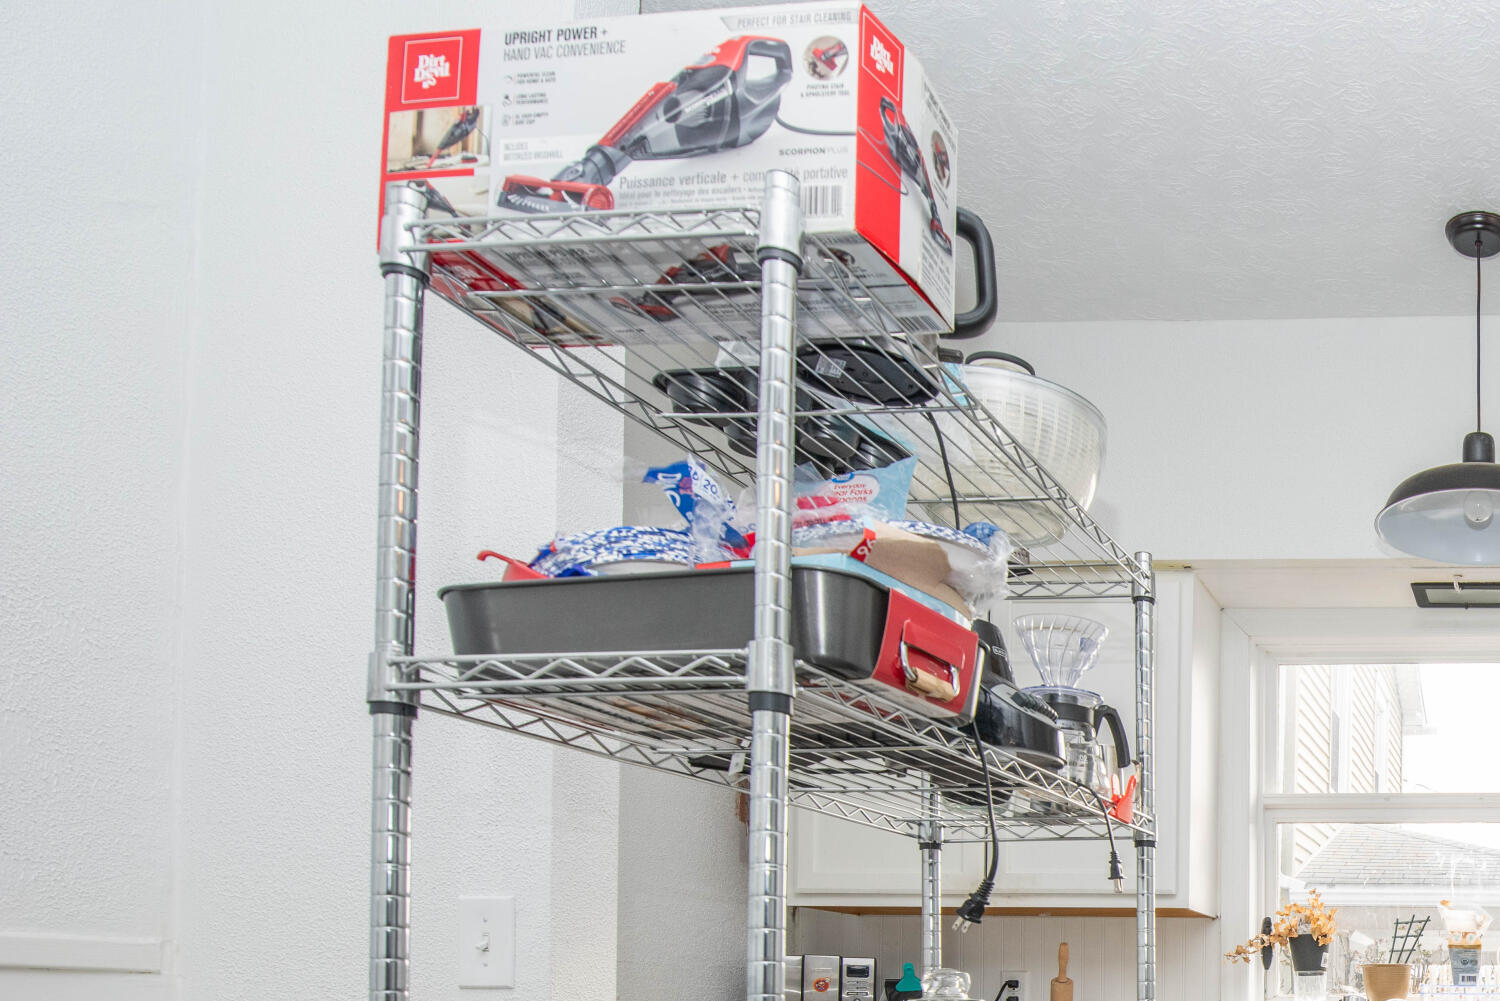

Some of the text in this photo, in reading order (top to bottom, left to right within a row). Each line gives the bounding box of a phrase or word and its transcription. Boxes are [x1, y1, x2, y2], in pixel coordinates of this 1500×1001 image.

[737, 11, 851, 28] PERFECT FOR STAIR CLEANING
[504, 30, 551, 46] UPRIGHT
[556, 27, 598, 42] POWER
[503, 40, 626, 62] HAND VAC CONVENIENCE
[418, 53, 446, 69] Dirt
[413, 62, 451, 87] Devil
[779, 147, 826, 156] SCORPION
[619, 176, 675, 191] Puissance
[679, 171, 727, 187] verticale
[803, 166, 848, 182] portative
